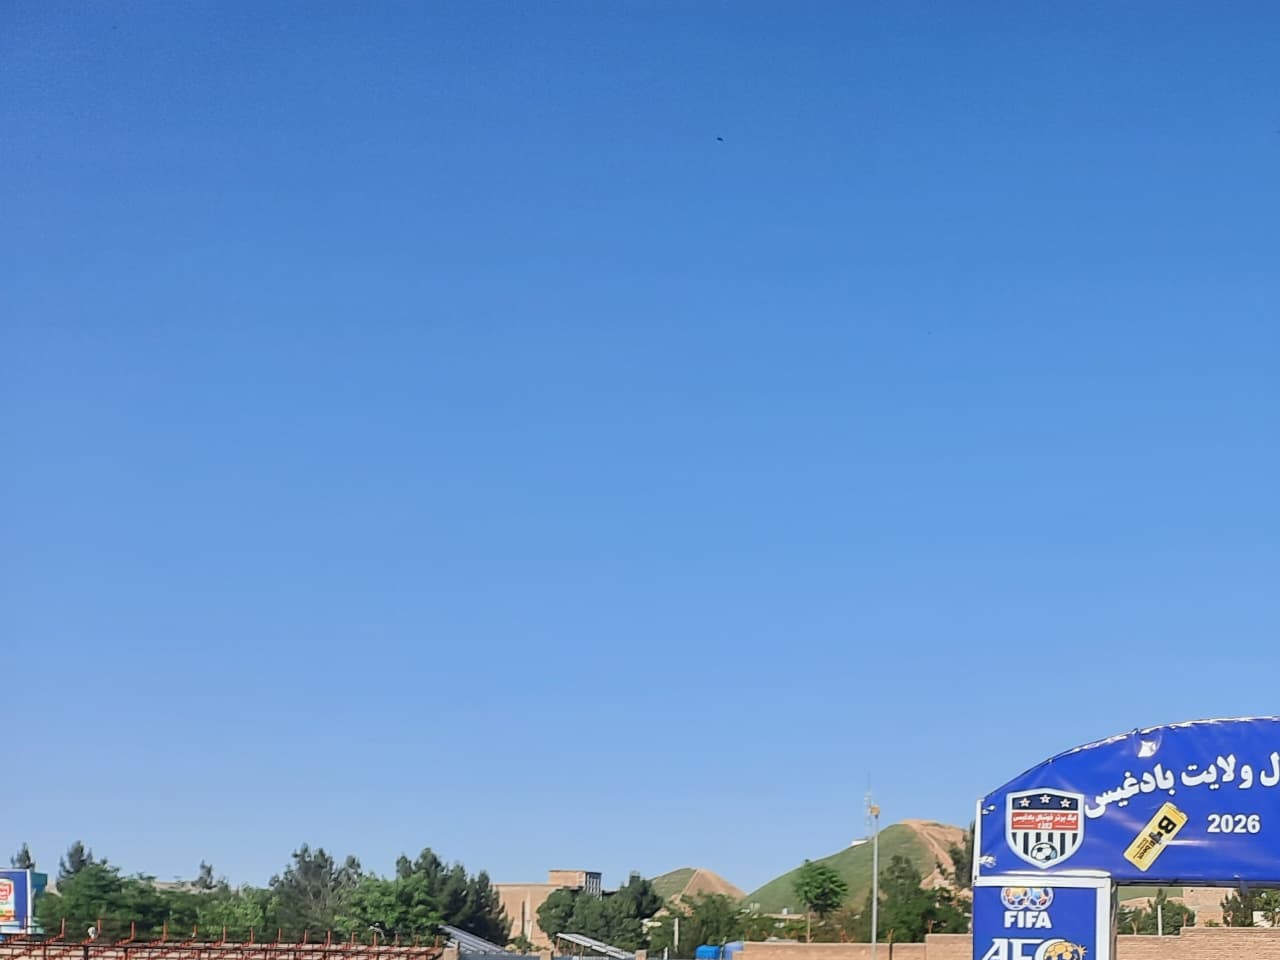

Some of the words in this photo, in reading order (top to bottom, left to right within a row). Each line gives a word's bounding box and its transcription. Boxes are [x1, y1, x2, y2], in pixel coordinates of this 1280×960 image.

[1181, 754, 1253, 790] ولایت
[1084, 763, 1175, 818] بادغیس
[1207, 814, 1261, 834] 2026
[1004, 911, 1052, 929] FIFA
